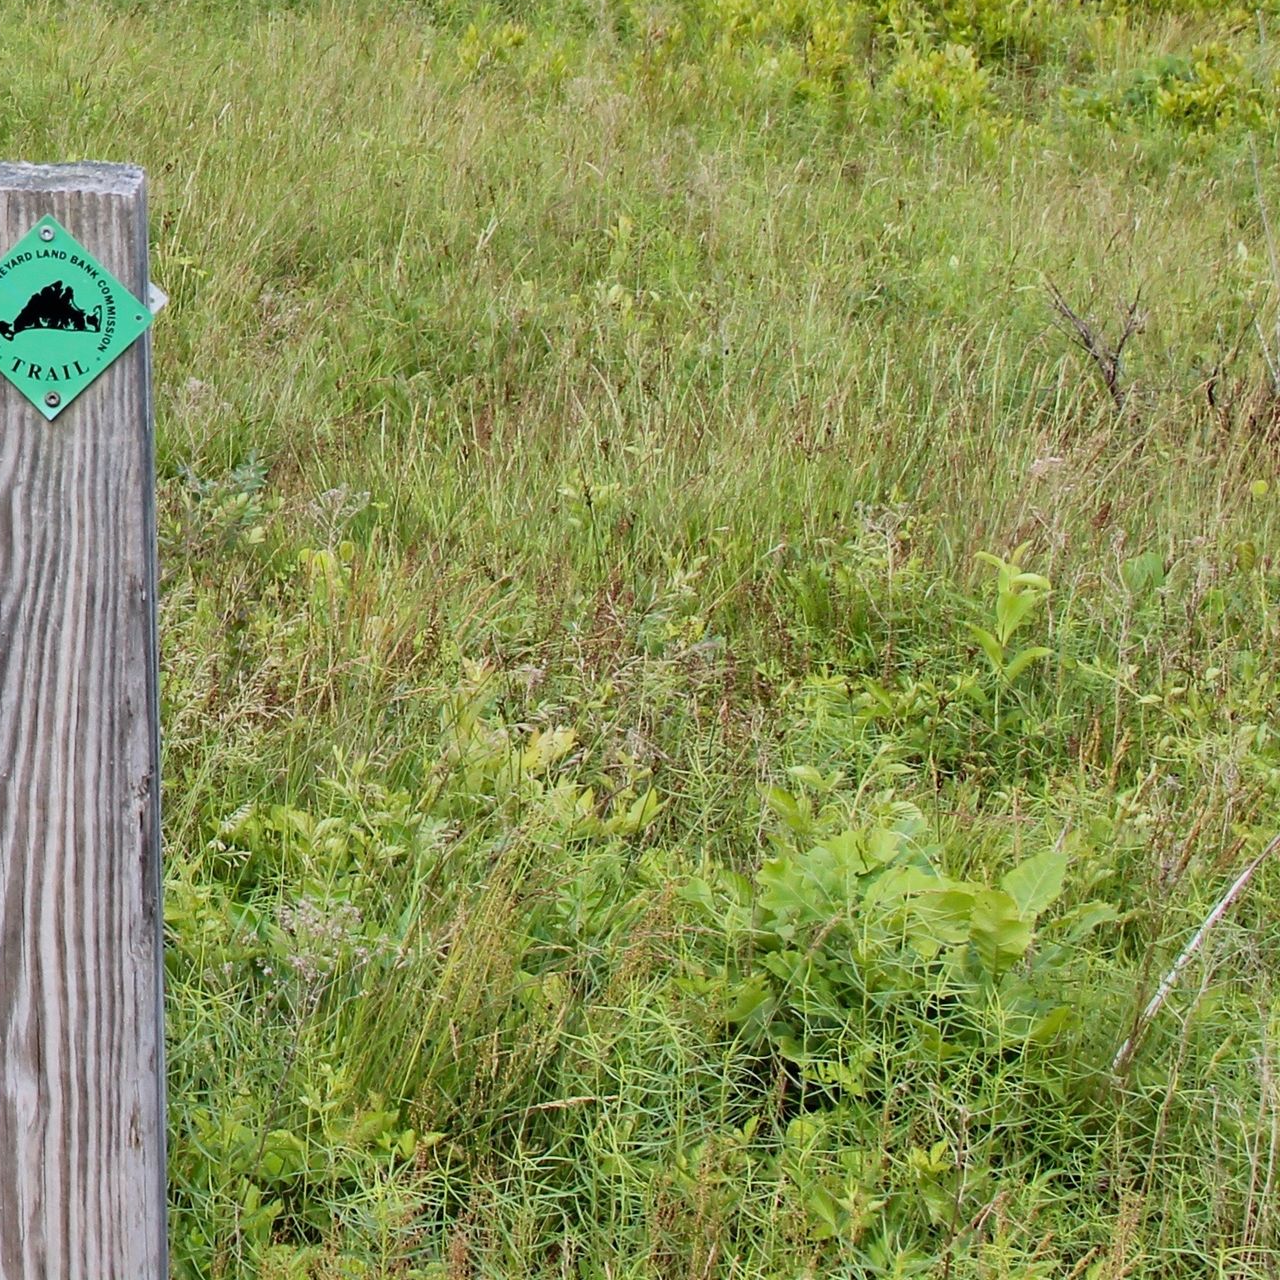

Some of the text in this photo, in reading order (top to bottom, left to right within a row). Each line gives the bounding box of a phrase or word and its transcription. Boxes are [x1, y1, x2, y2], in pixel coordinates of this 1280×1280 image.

[36, 249, 67, 260] LAND
[69, 255, 99, 280] BANK
[97, 279, 116, 353] COMMISSION
[11, 356, 90, 382] TRAIL
